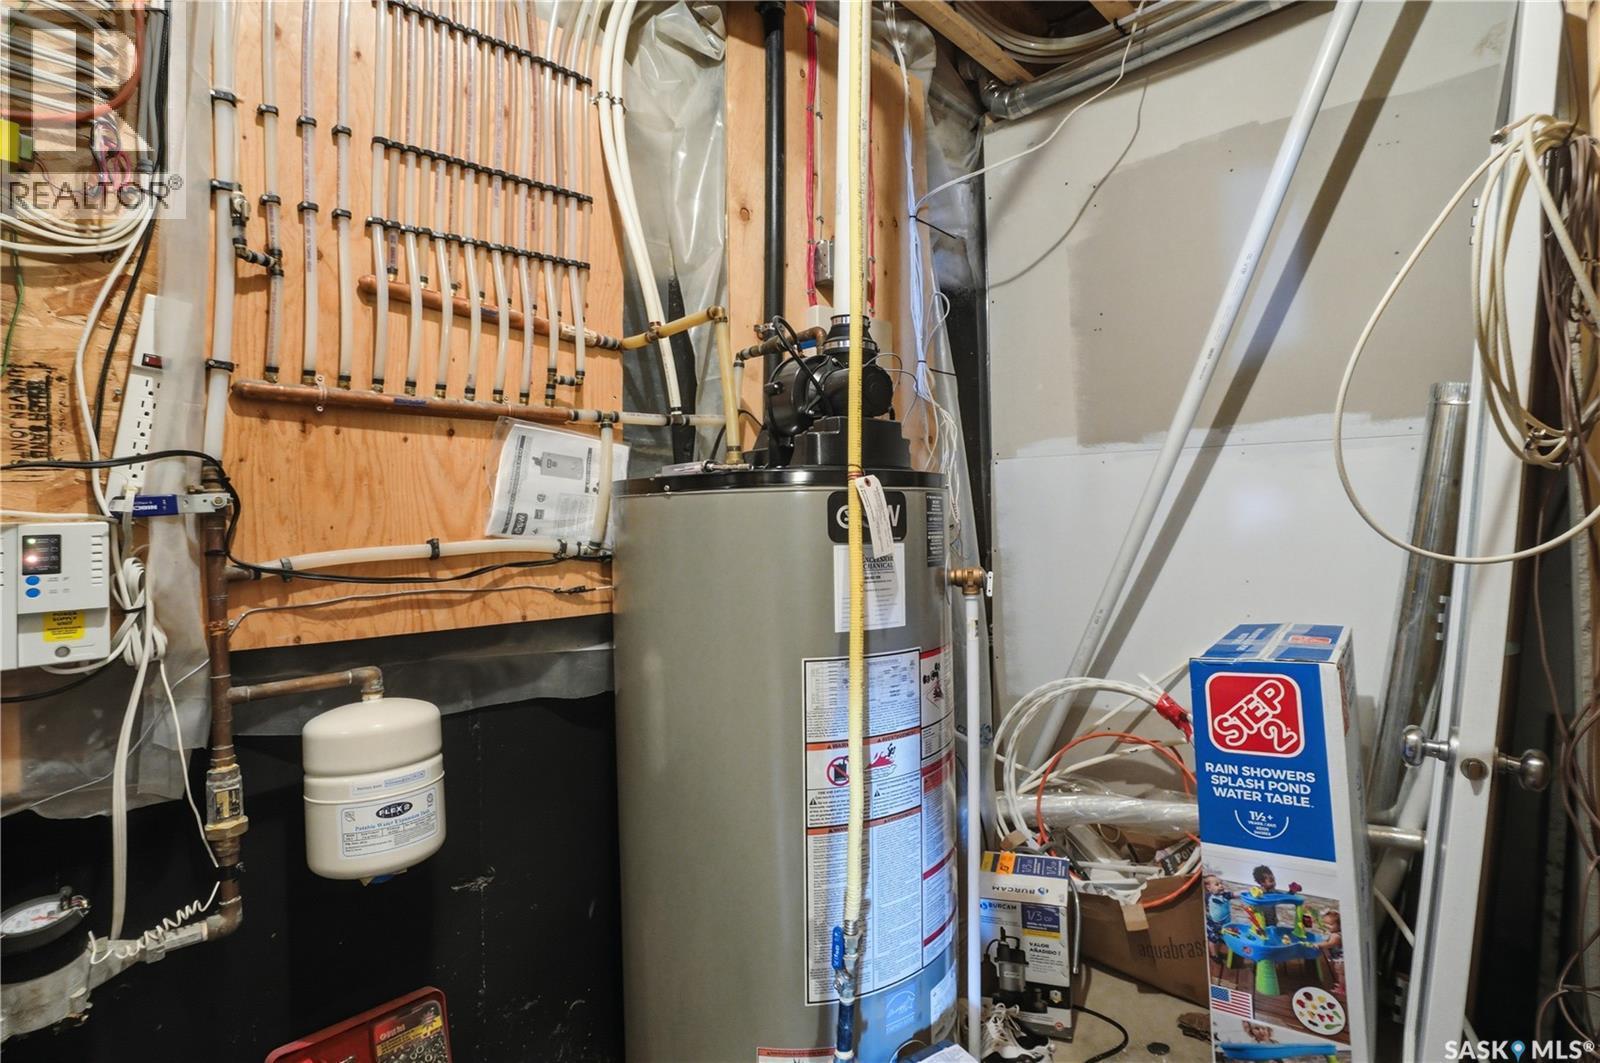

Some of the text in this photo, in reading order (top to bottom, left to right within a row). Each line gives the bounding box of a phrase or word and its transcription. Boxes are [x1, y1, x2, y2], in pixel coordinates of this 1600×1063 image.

[1213, 679, 1285, 746] STEP
[1205, 762, 1316, 783] RAIN SHOWERS
[1211, 774, 1311, 795] SPLASH POND
[1213, 786, 1262, 802] WATER
[992, 885, 1035, 895] BURCAM
